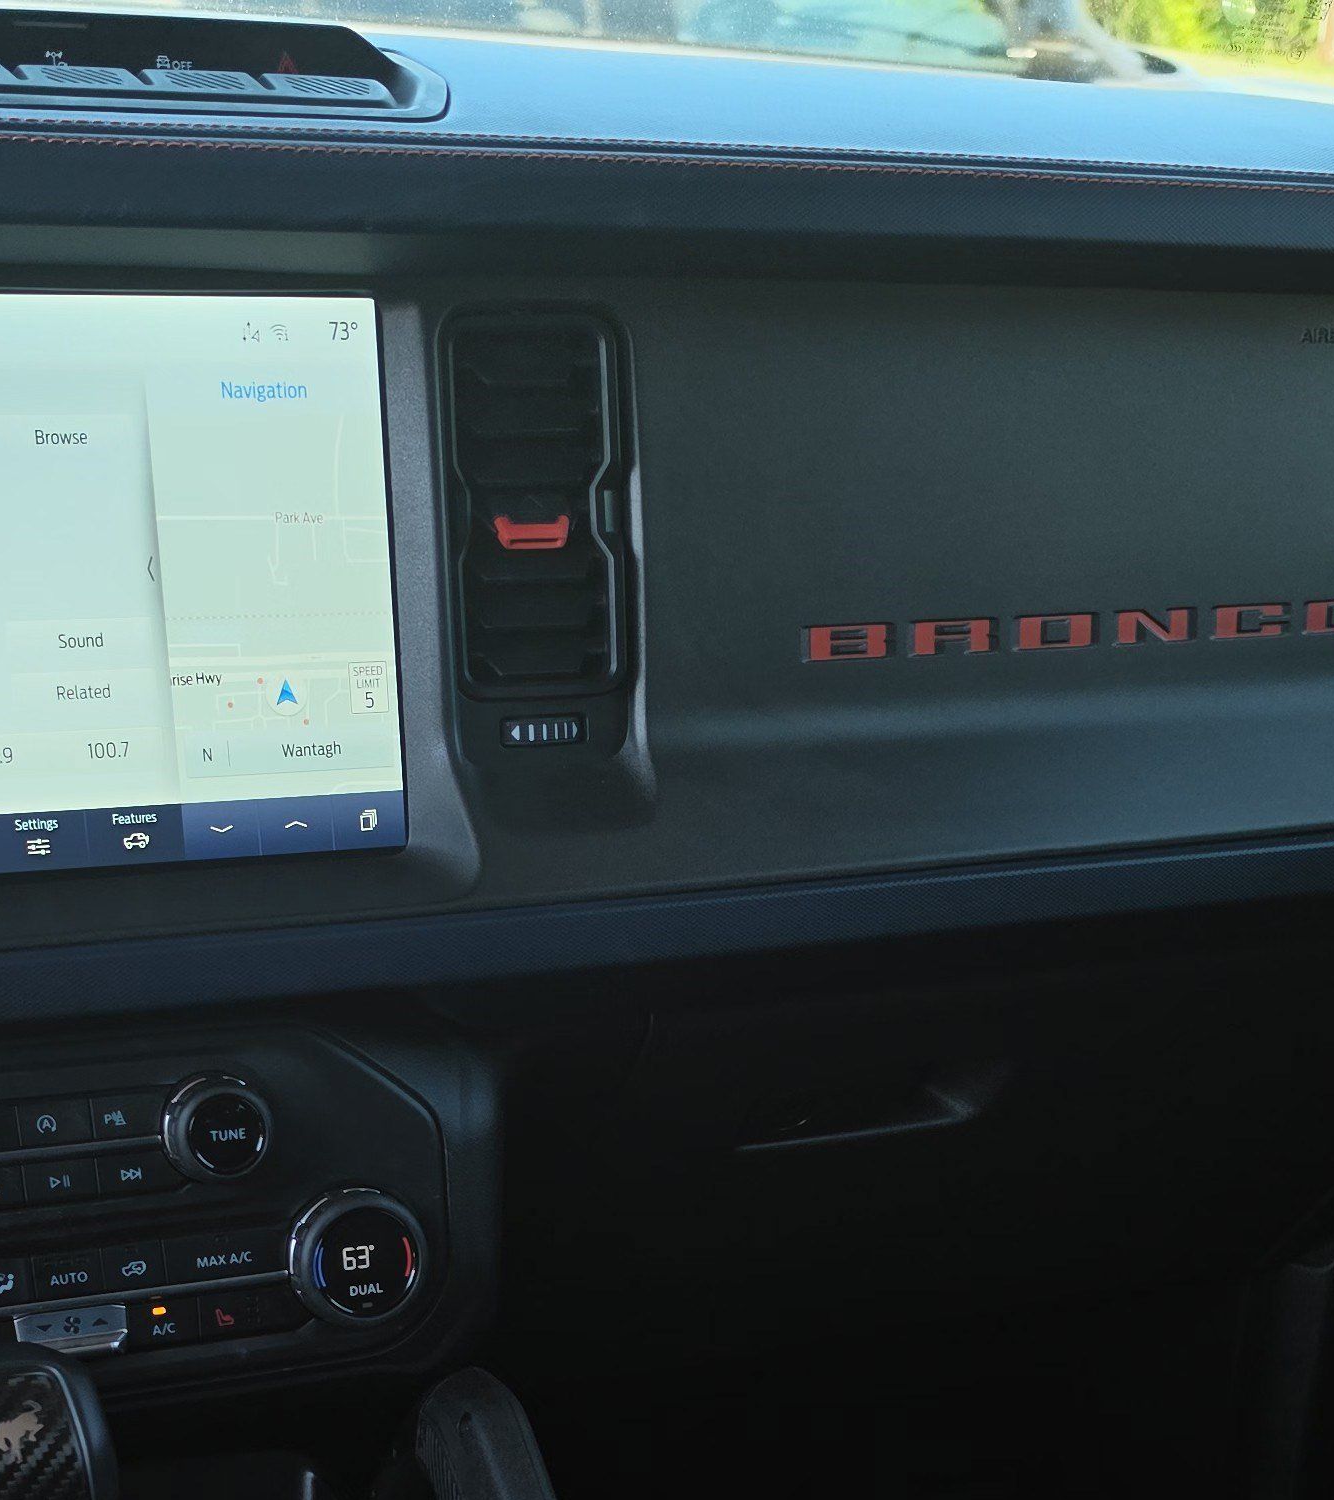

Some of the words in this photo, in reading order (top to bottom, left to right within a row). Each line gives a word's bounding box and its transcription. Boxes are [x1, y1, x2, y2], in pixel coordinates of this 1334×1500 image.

[171, 60, 193, 71] OFF
[328, 321, 359, 342] 73°
[220, 381, 308, 403] Navigation
[34, 429, 88, 446] Browse
[274, 511, 300, 524] Park
[302, 511, 324, 524] Ave
[58, 631, 104, 650] Sound
[170, 673, 193, 687] rise
[195, 671, 222, 687] Hwy
[352, 666, 383, 677] SPEED
[356, 678, 380, 690] LIMIT
[56, 683, 111, 702] Related
[365, 691, 375, 708] 5
[87, 741, 130, 760] 100.7
[202, 747, 213, 762] N
[281, 741, 342, 758] Wantagh
[14, 817, 59, 833] Settings
[112, 811, 158, 826] Features
[210, 1128, 247, 1142] TUNE
[196, 1253, 227, 1269] MAX
[229, 1250, 253, 1266] A/C
[341, 1243, 375, 1271] 63°
[50, 1270, 89, 1286] AUTO
[349, 1282, 384, 1297] DUAL
[152, 1322, 177, 1336] A/C
